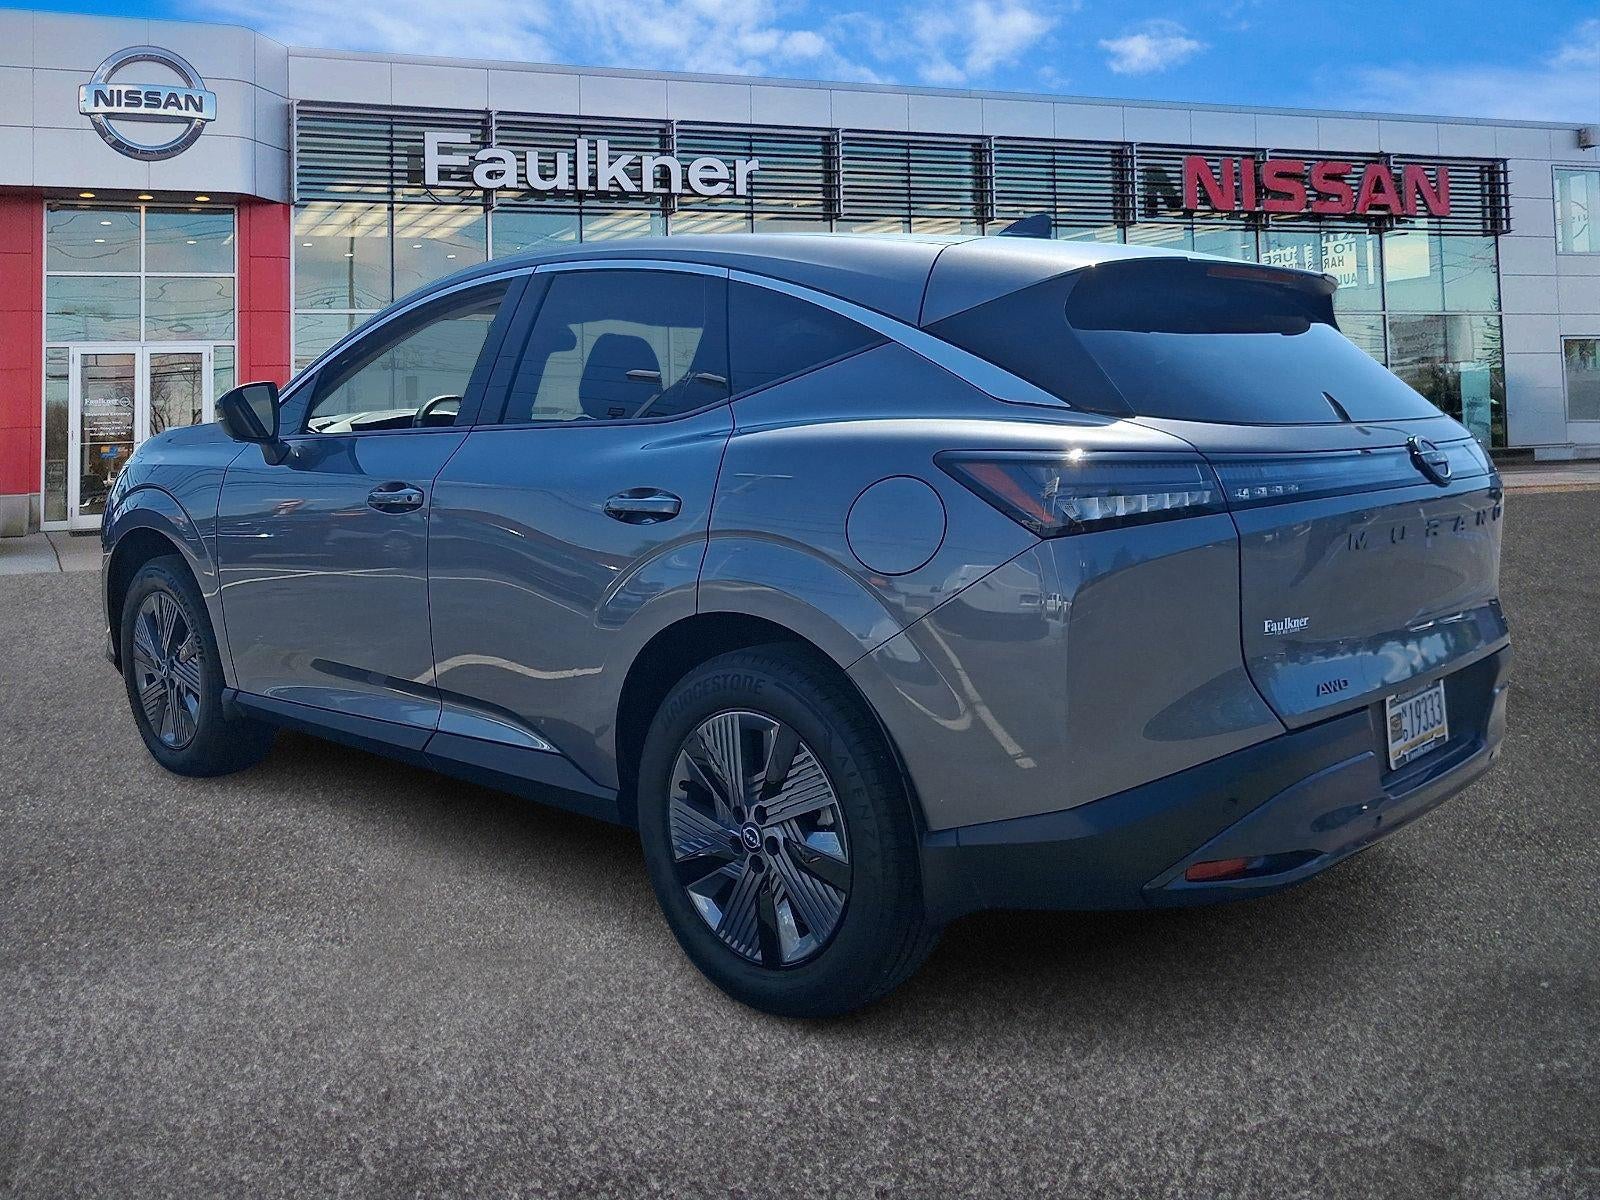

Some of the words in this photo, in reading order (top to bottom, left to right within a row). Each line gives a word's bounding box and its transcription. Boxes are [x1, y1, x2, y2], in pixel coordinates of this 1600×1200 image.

[93, 89, 204, 113] NISSAN
[423, 131, 760, 197] Faulkner
[1182, 155, 1450, 216] NISSAN
[1264, 616, 1310, 633] Faulkner
[1316, 678, 1349, 697] AWD
